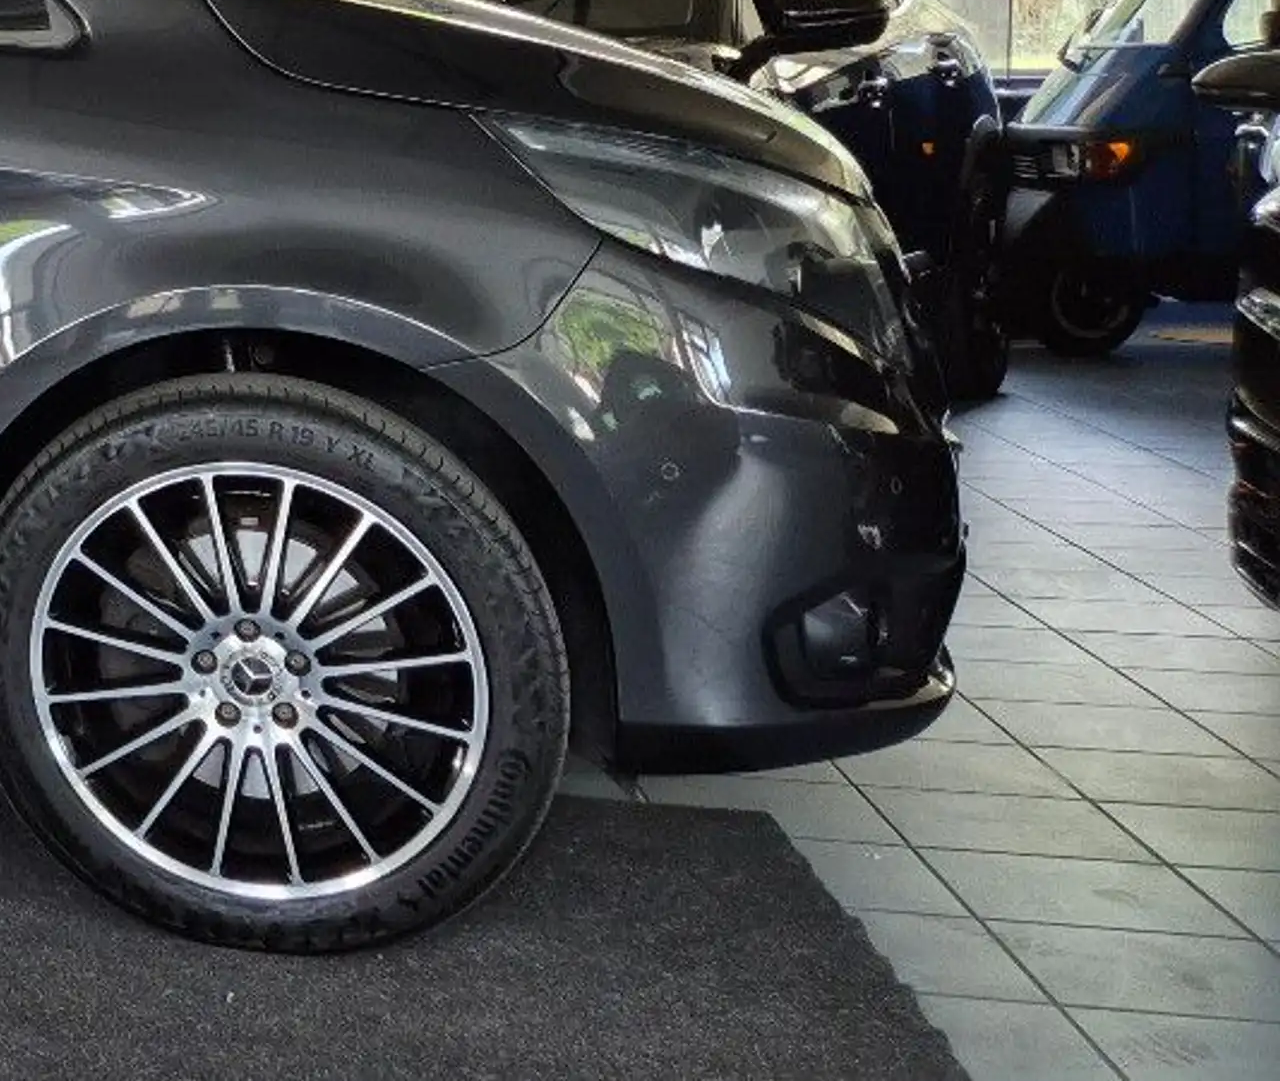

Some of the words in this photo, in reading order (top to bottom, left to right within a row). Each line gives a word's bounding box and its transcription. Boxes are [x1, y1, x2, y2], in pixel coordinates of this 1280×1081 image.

[268, 421, 285, 441] R
[291, 425, 315, 447] 19
[415, 747, 533, 899] Continental
